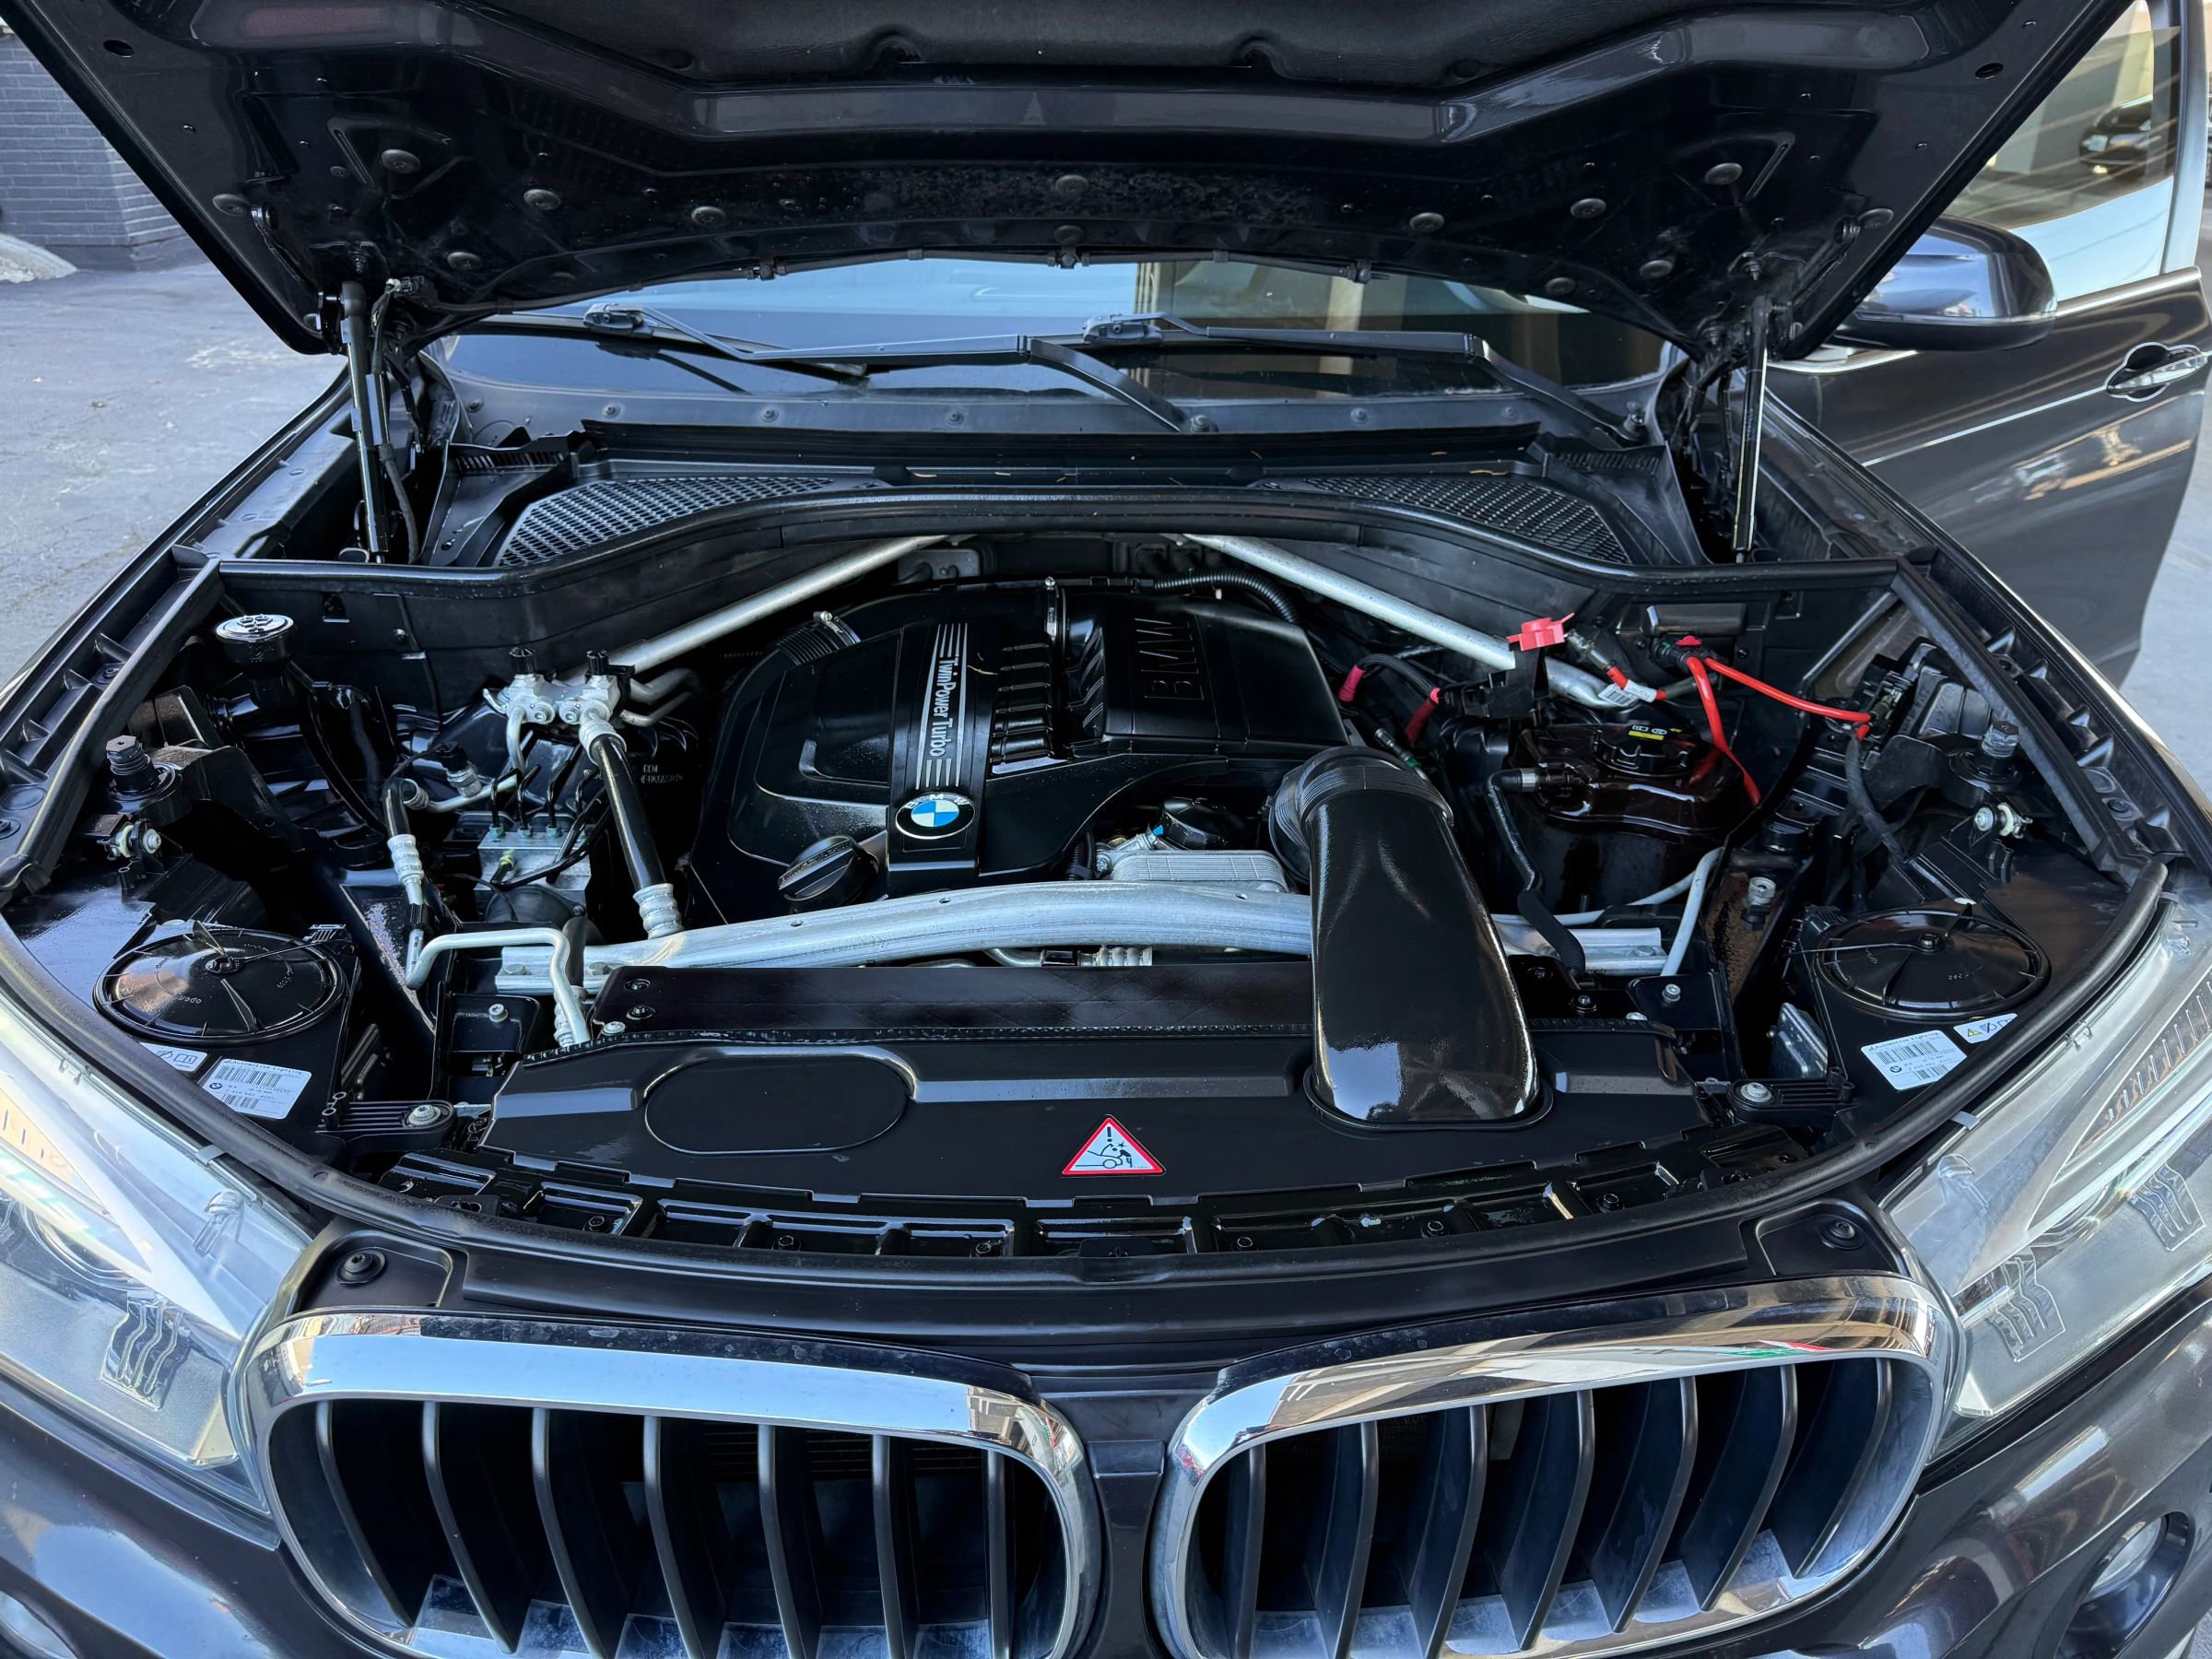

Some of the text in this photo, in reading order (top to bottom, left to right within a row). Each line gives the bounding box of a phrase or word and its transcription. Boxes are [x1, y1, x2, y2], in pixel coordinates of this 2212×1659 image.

[1135, 618, 1205, 700] BMW
[929, 655, 959, 757] TwinPower Turbo
[903, 794, 971, 809] BMW
[178, 994, 203, 1005] open
[233, 1060, 270, 1069] Automotive
